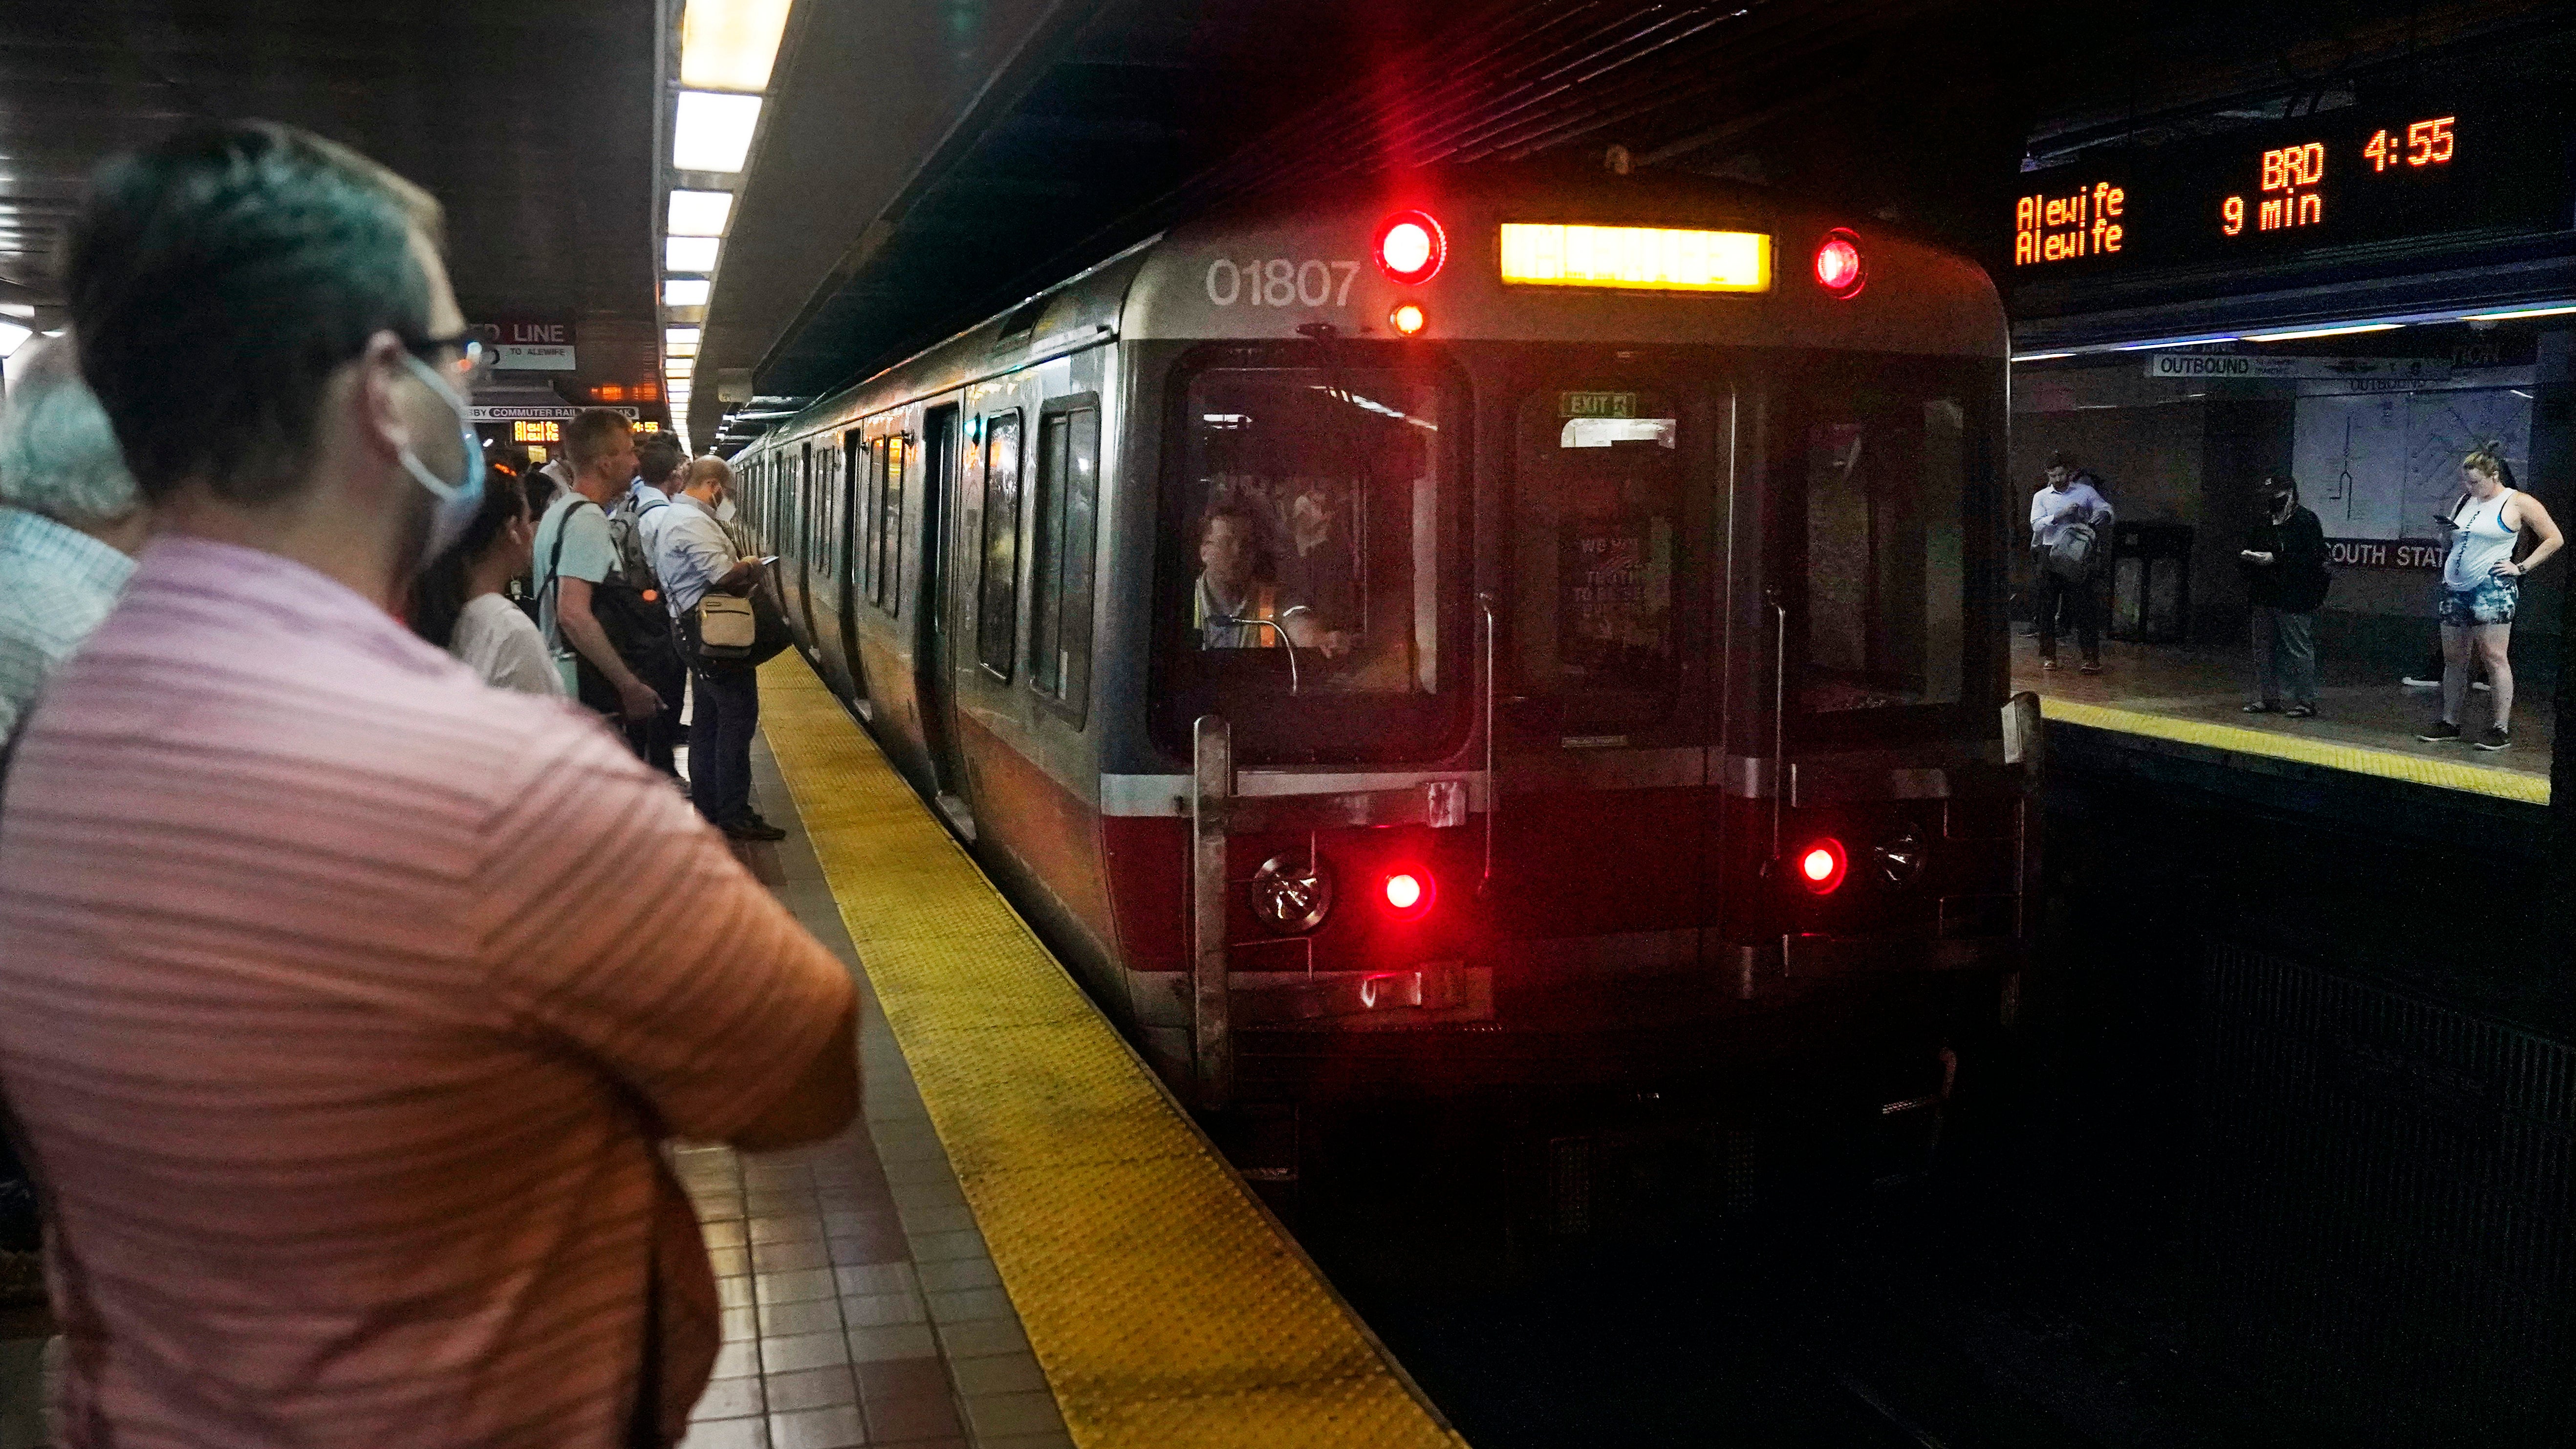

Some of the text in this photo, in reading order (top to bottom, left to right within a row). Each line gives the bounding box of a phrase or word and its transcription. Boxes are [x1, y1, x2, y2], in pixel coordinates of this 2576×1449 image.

[2016, 116, 2455, 231] Alewife BRD 4:55
[2015, 186, 2322, 265] Alewife 9 min
[1206, 258, 1361, 306] 01807
[513, 324, 564, 342] LINE
[2160, 358, 2249, 373] OUTBOUND
[1571, 395, 1608, 413] EXIT
[514, 421, 659, 433] Alewife 4:55
[514, 431, 560, 442] Alewife
